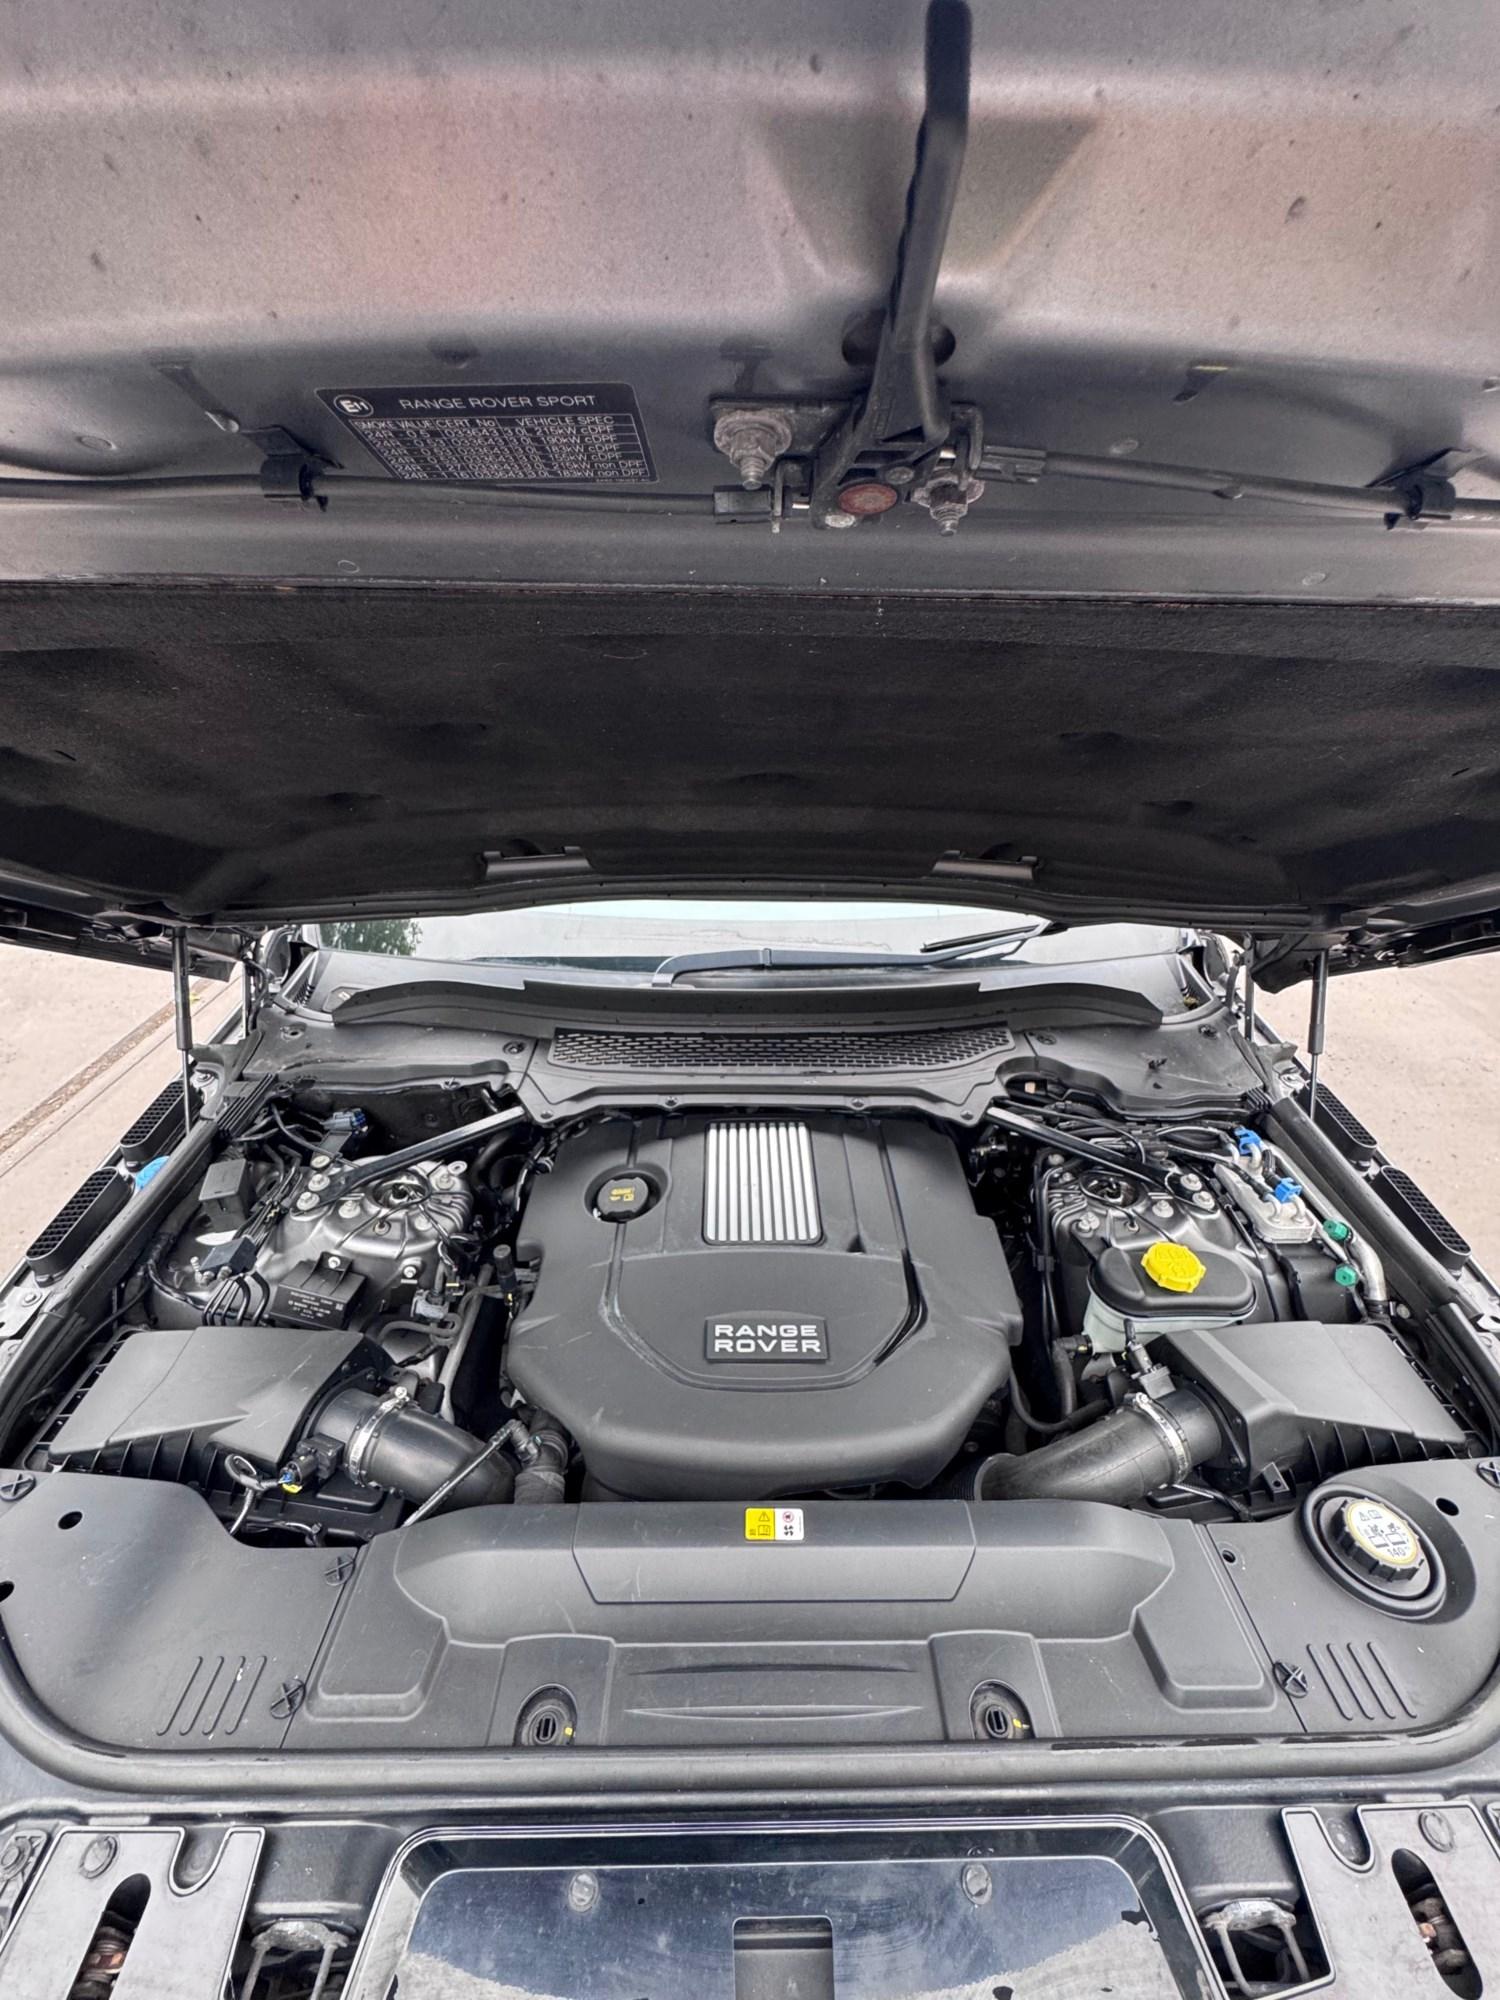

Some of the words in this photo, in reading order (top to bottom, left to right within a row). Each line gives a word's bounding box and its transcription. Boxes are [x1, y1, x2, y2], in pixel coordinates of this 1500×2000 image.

[400, 399, 466, 409] RANGE
[468, 397, 533, 408] ROVER
[536, 395, 595, 407] SPORT
[353, 421, 397, 429] SMOKE
[397, 420, 434, 428] VALUE
[436, 419, 472, 427] CERT
[516, 417, 575, 425] VEHICLE
[578, 416, 615, 424] SPEC
[714, 1324, 818, 1337] RANGE
[714, 1339, 821, 1353] ROVER
